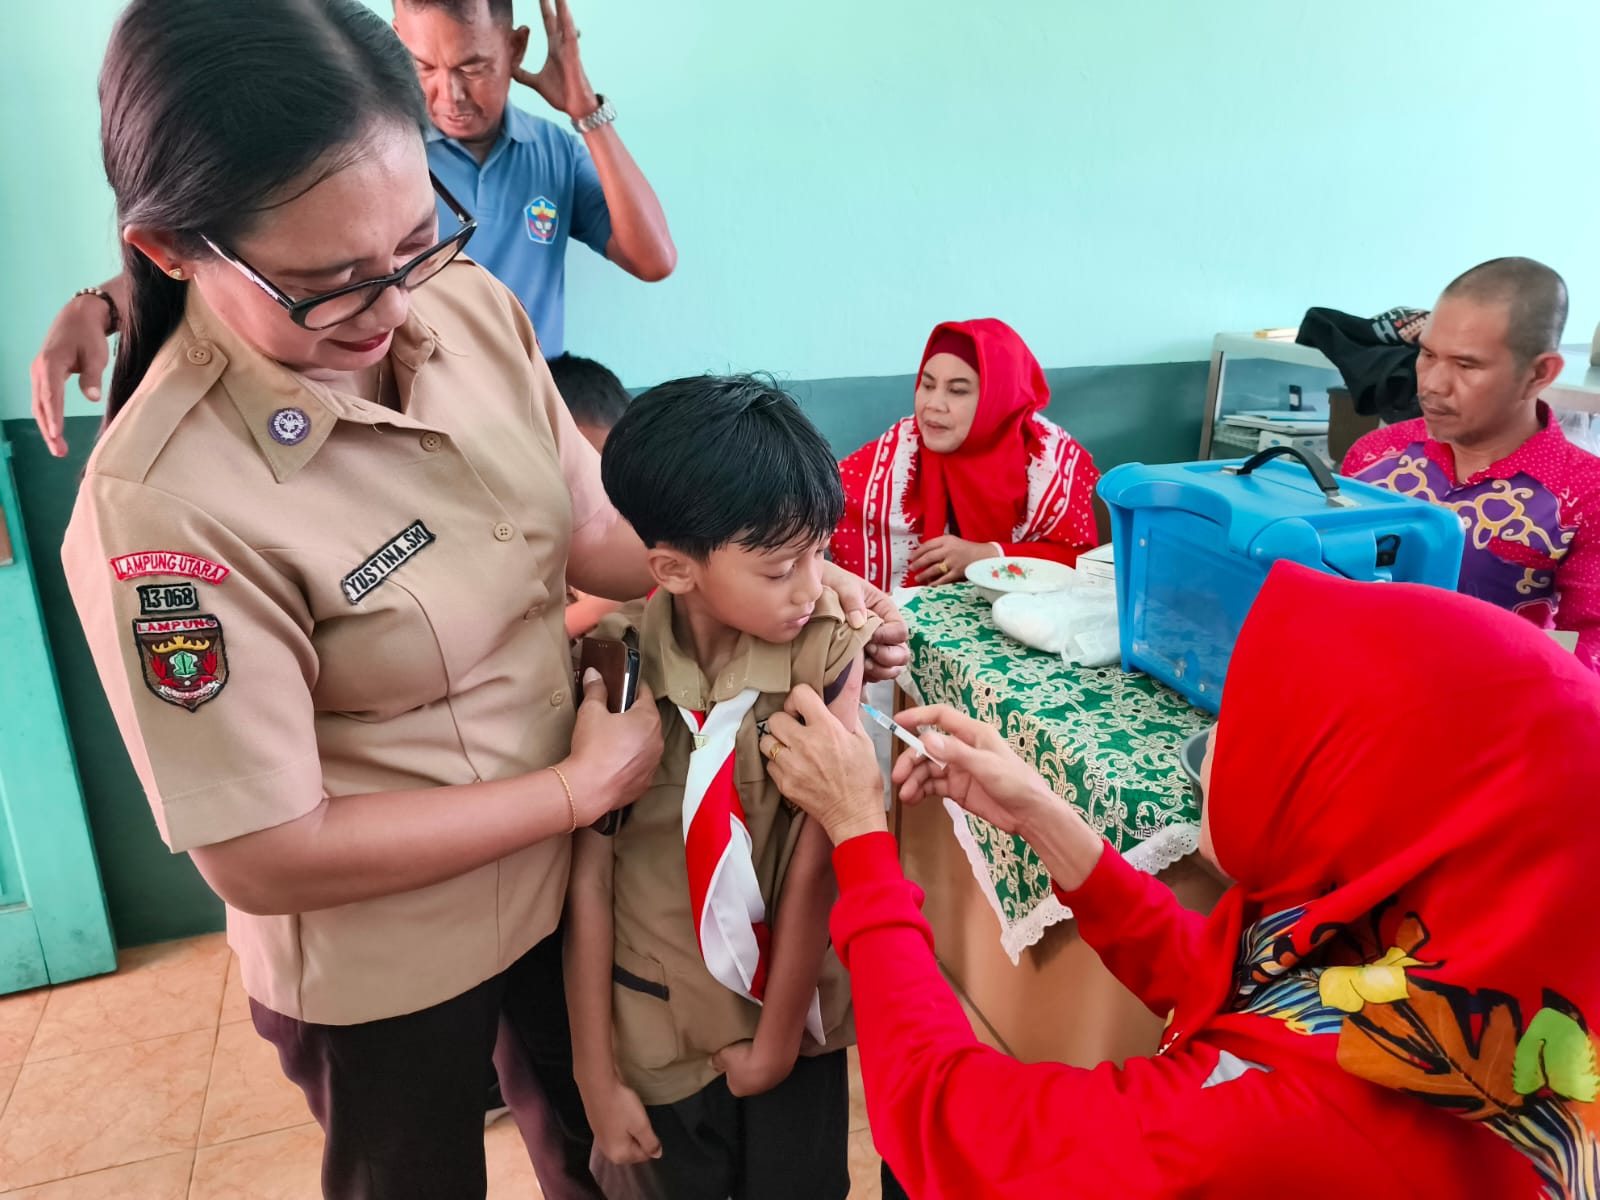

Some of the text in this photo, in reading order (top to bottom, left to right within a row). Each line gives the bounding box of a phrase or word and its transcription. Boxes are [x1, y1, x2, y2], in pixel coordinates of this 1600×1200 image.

[117, 554, 219, 580] LAMPUNG UTARA
[144, 588, 194, 608] 13-068
[137, 618, 216, 632] LAMPUNG
